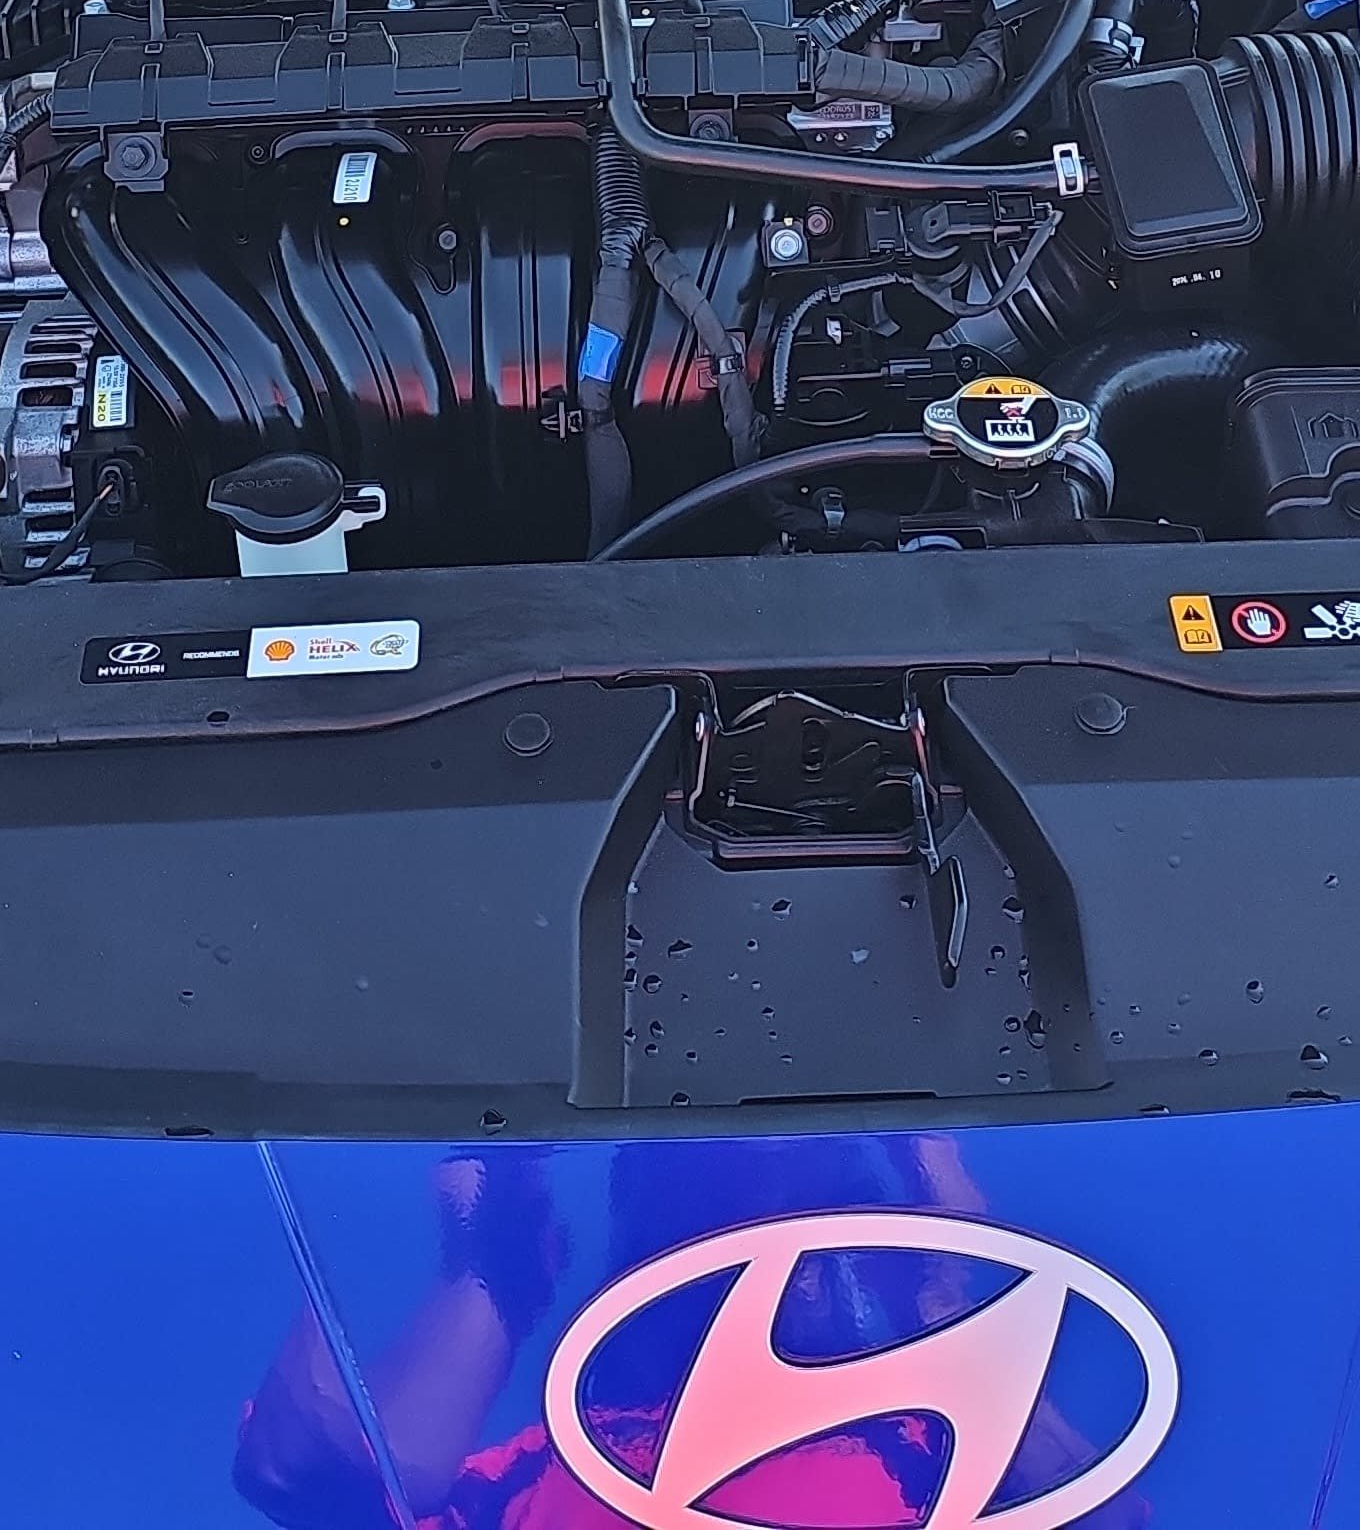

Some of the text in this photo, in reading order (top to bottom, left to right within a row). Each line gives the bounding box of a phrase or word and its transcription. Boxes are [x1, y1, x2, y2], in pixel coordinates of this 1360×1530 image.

[98, 394, 106, 422] N20
[97, 664, 165, 677] HYUNDAI
[309, 643, 358, 654] HELIX
